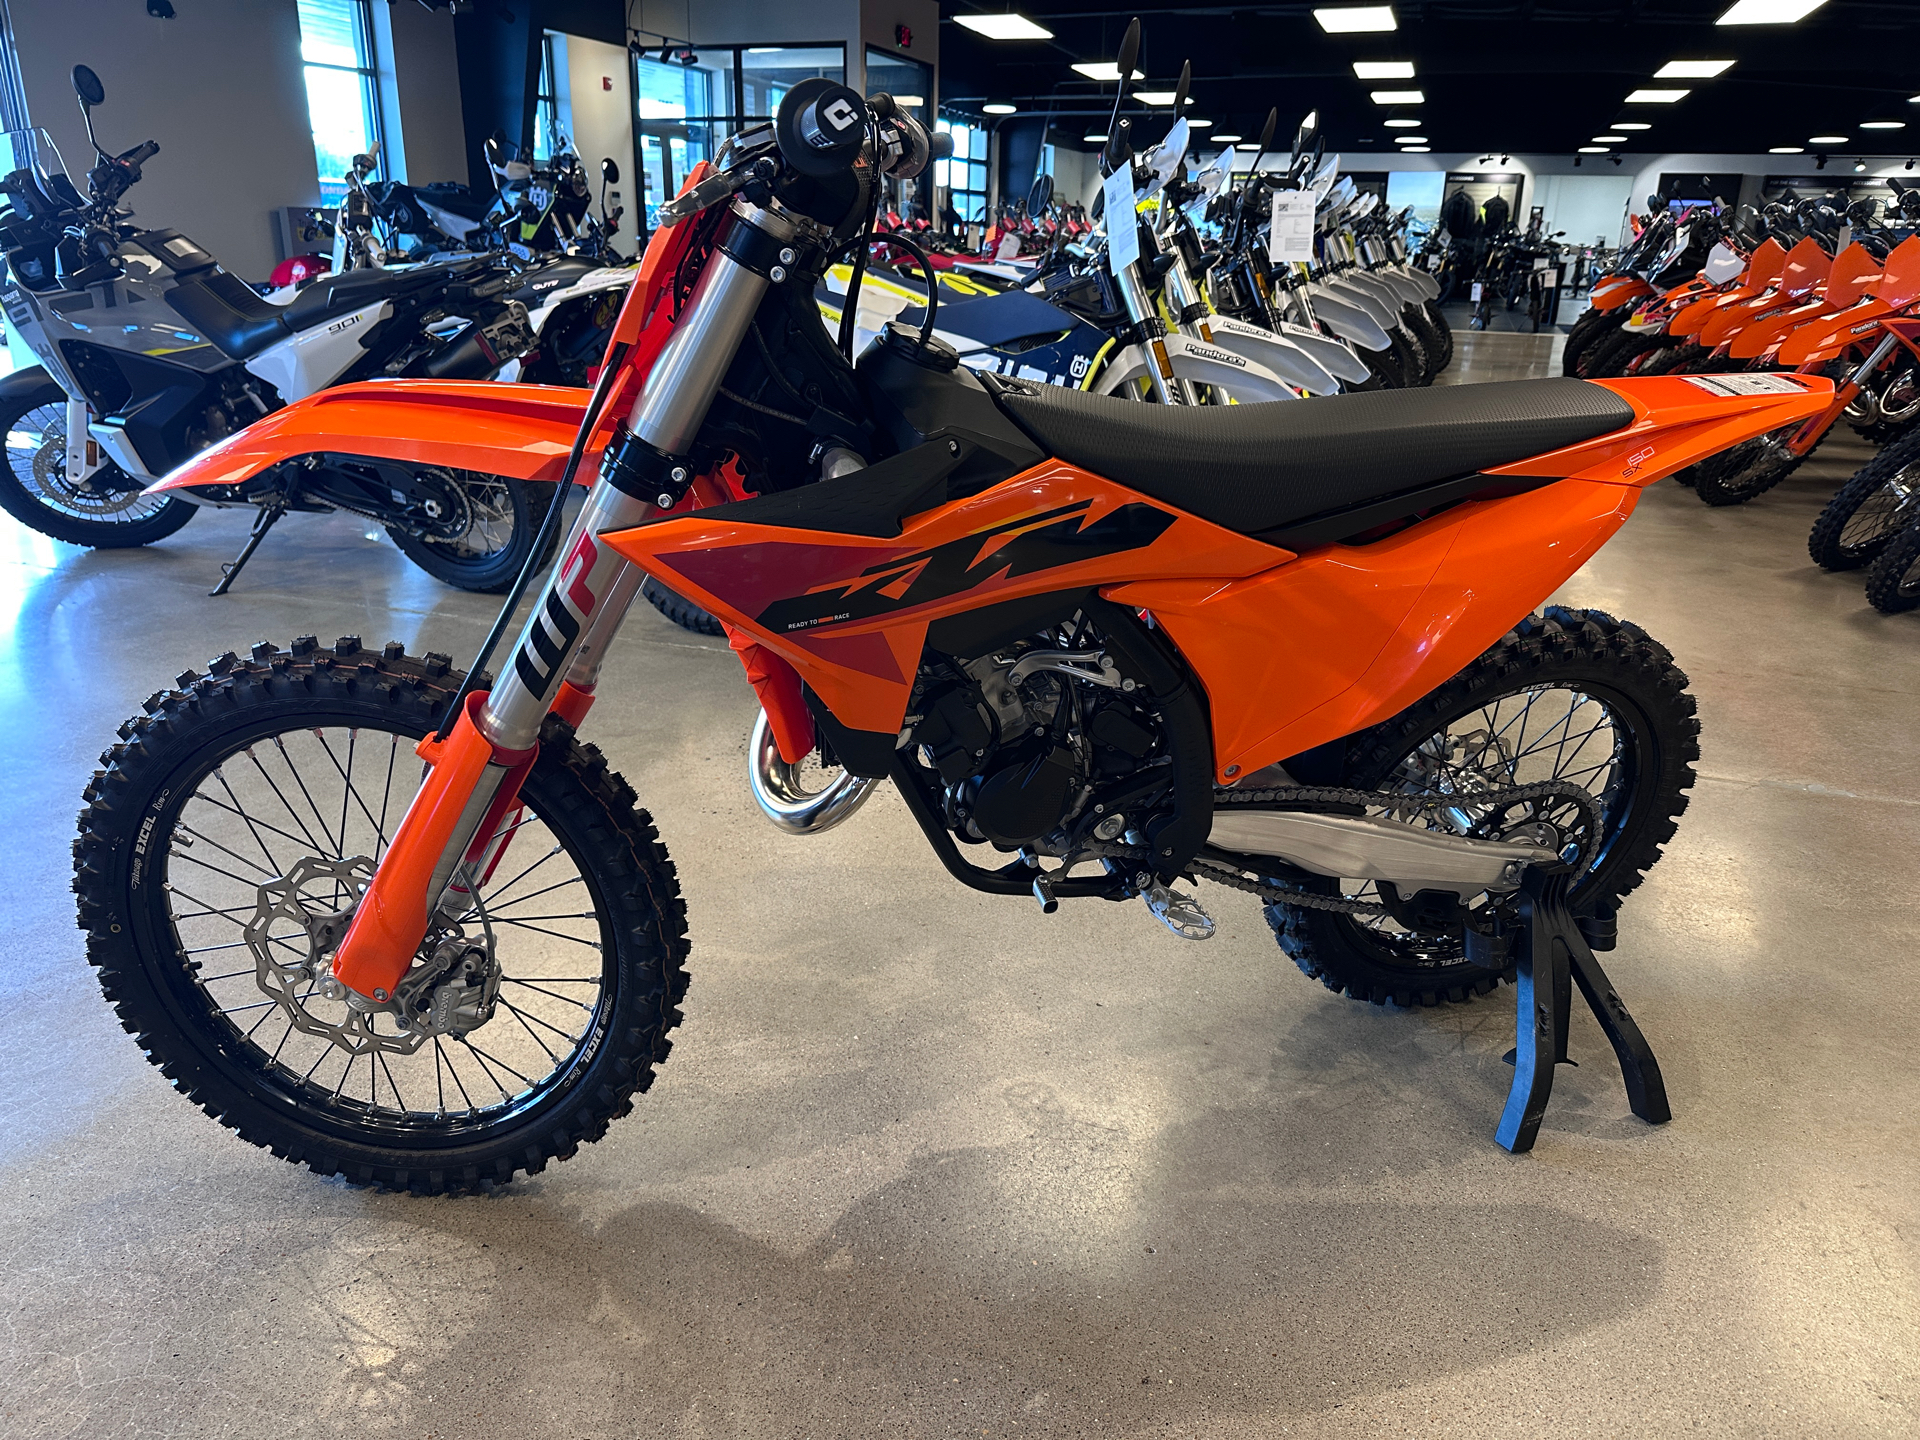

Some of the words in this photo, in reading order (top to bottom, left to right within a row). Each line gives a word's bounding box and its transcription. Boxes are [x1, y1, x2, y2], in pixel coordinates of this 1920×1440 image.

[1223, 321, 1272, 339] Pandora's
[1186, 343, 1246, 367] Pandora's
[1627, 446, 1655, 467] 150
[1622, 463, 1643, 479] SX
[788, 621, 809, 630] READY
[834, 612, 850, 620] RACE
[1520, 682, 1556, 693] EXCEL
[135, 816, 156, 855] EXCEL
[152, 788, 170, 811] Rim
[437, 991, 453, 1029] brembo
[580, 1026, 604, 1064] EXCEL
[564, 1066, 582, 1088] Rim
